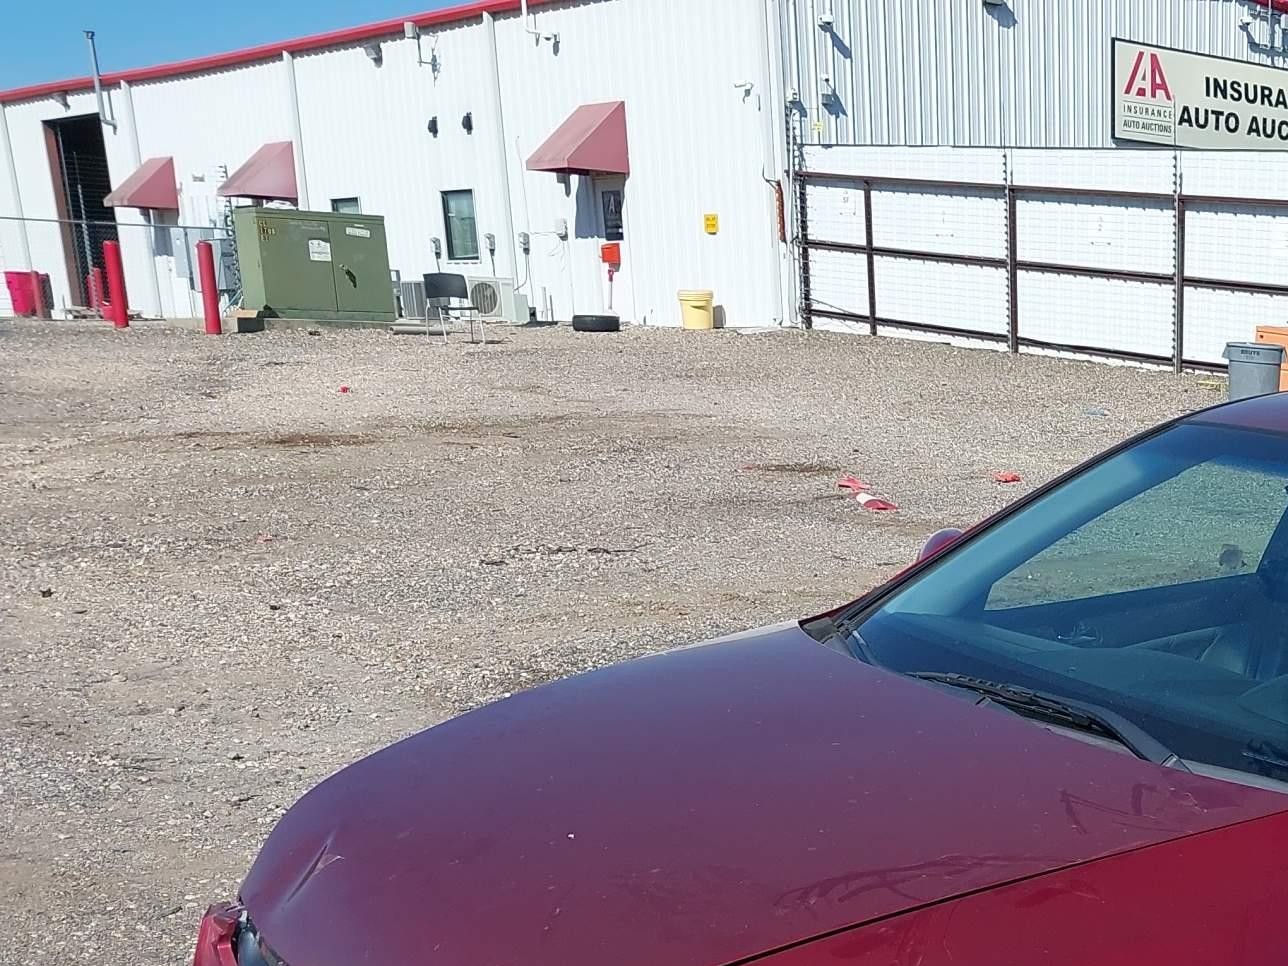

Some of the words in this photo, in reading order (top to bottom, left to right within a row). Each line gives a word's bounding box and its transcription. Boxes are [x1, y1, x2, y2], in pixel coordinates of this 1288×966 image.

[1123, 104, 1172, 119] INSURANCE
[1177, 105, 1240, 133] AUTO
[1123, 119, 1140, 130] AUTO
[1141, 121, 1172, 134] AUCTIONS
